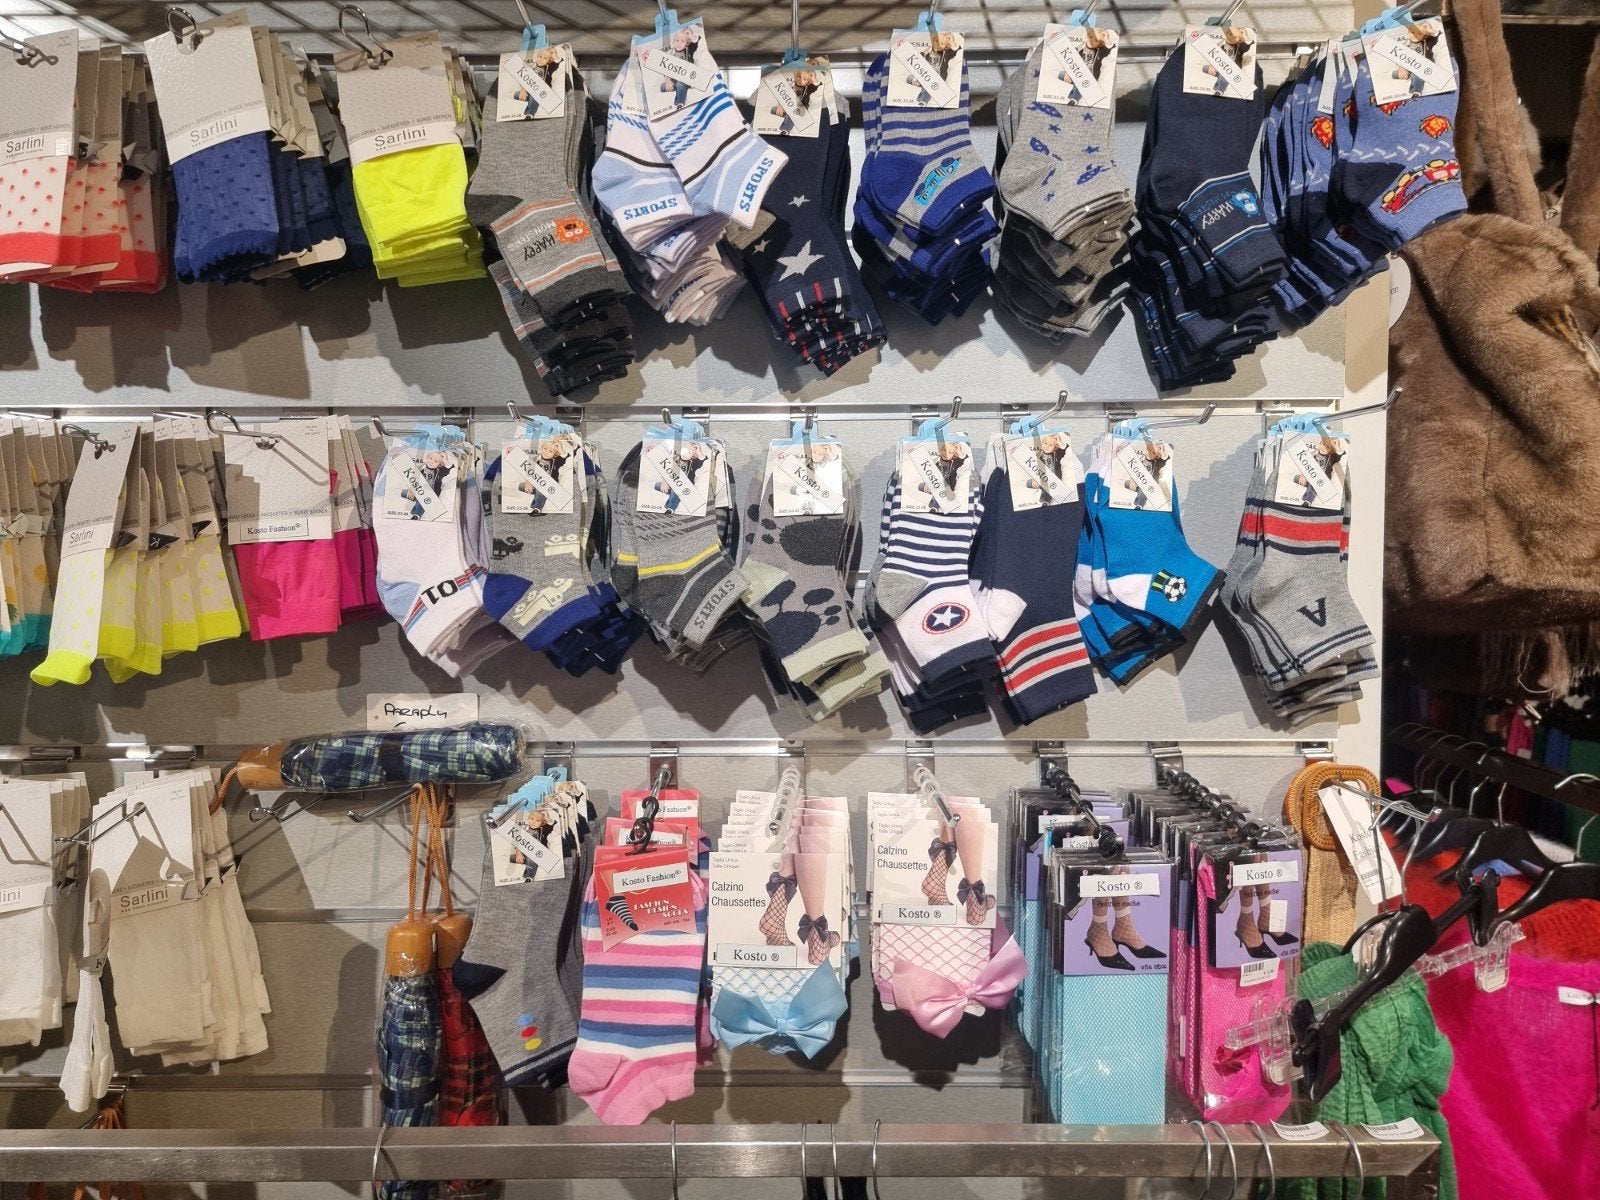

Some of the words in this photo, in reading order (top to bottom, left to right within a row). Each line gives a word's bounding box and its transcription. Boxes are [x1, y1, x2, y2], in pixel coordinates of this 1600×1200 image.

[659, 56, 687, 76] Kosto
[906, 54, 931, 82] Kosto
[1060, 47, 1083, 78] Kosto
[1208, 47, 1233, 75] Kosto
[1390, 45, 1422, 70] Kosto
[516, 66, 540, 91] Kosto
[775, 82, 795, 108] Kosto
[190, 116, 238, 143] Sarlini
[374, 126, 426, 147] Sarlini
[6, 135, 45, 153] Sarlini
[739, 157, 774, 213] SPORTS
[623, 197, 678, 220] SPORTS
[1201, 201, 1234, 230] HAPPY
[523, 234, 556, 261] HAPPY
[520, 460, 546, 487] Kosto
[660, 458, 682, 487] Kosto
[920, 460, 940, 489] Kosto
[1025, 456, 1048, 483] Kosto
[1128, 458, 1148, 485] Kosto
[1296, 450, 1318, 479] Kosto
[403, 467, 425, 496] Kosto
[794, 466, 820, 492] Kosto
[70, 527, 96, 544] Sarlini
[247, 527, 268, 535] Kosto
[694, 580, 735, 629] SPORTS
[1296, 596, 1327, 627] A
[508, 826, 534, 852] Kosto
[1349, 830, 1373, 844] Kosto
[877, 844, 908, 856] Calzino
[877, 858, 928, 870] Chaussettes
[1246, 869, 1274, 880] Kosto
[622, 878, 645, 886] Kosto
[711, 881, 744, 892] Calzino
[1096, 880, 1130, 892] Kosto
[120, 886, 168, 907] Sarlini
[711, 896, 766, 907] Chaussettes
[898, 908, 930, 918] Kosto
[734, 949, 767, 962] Kosto
